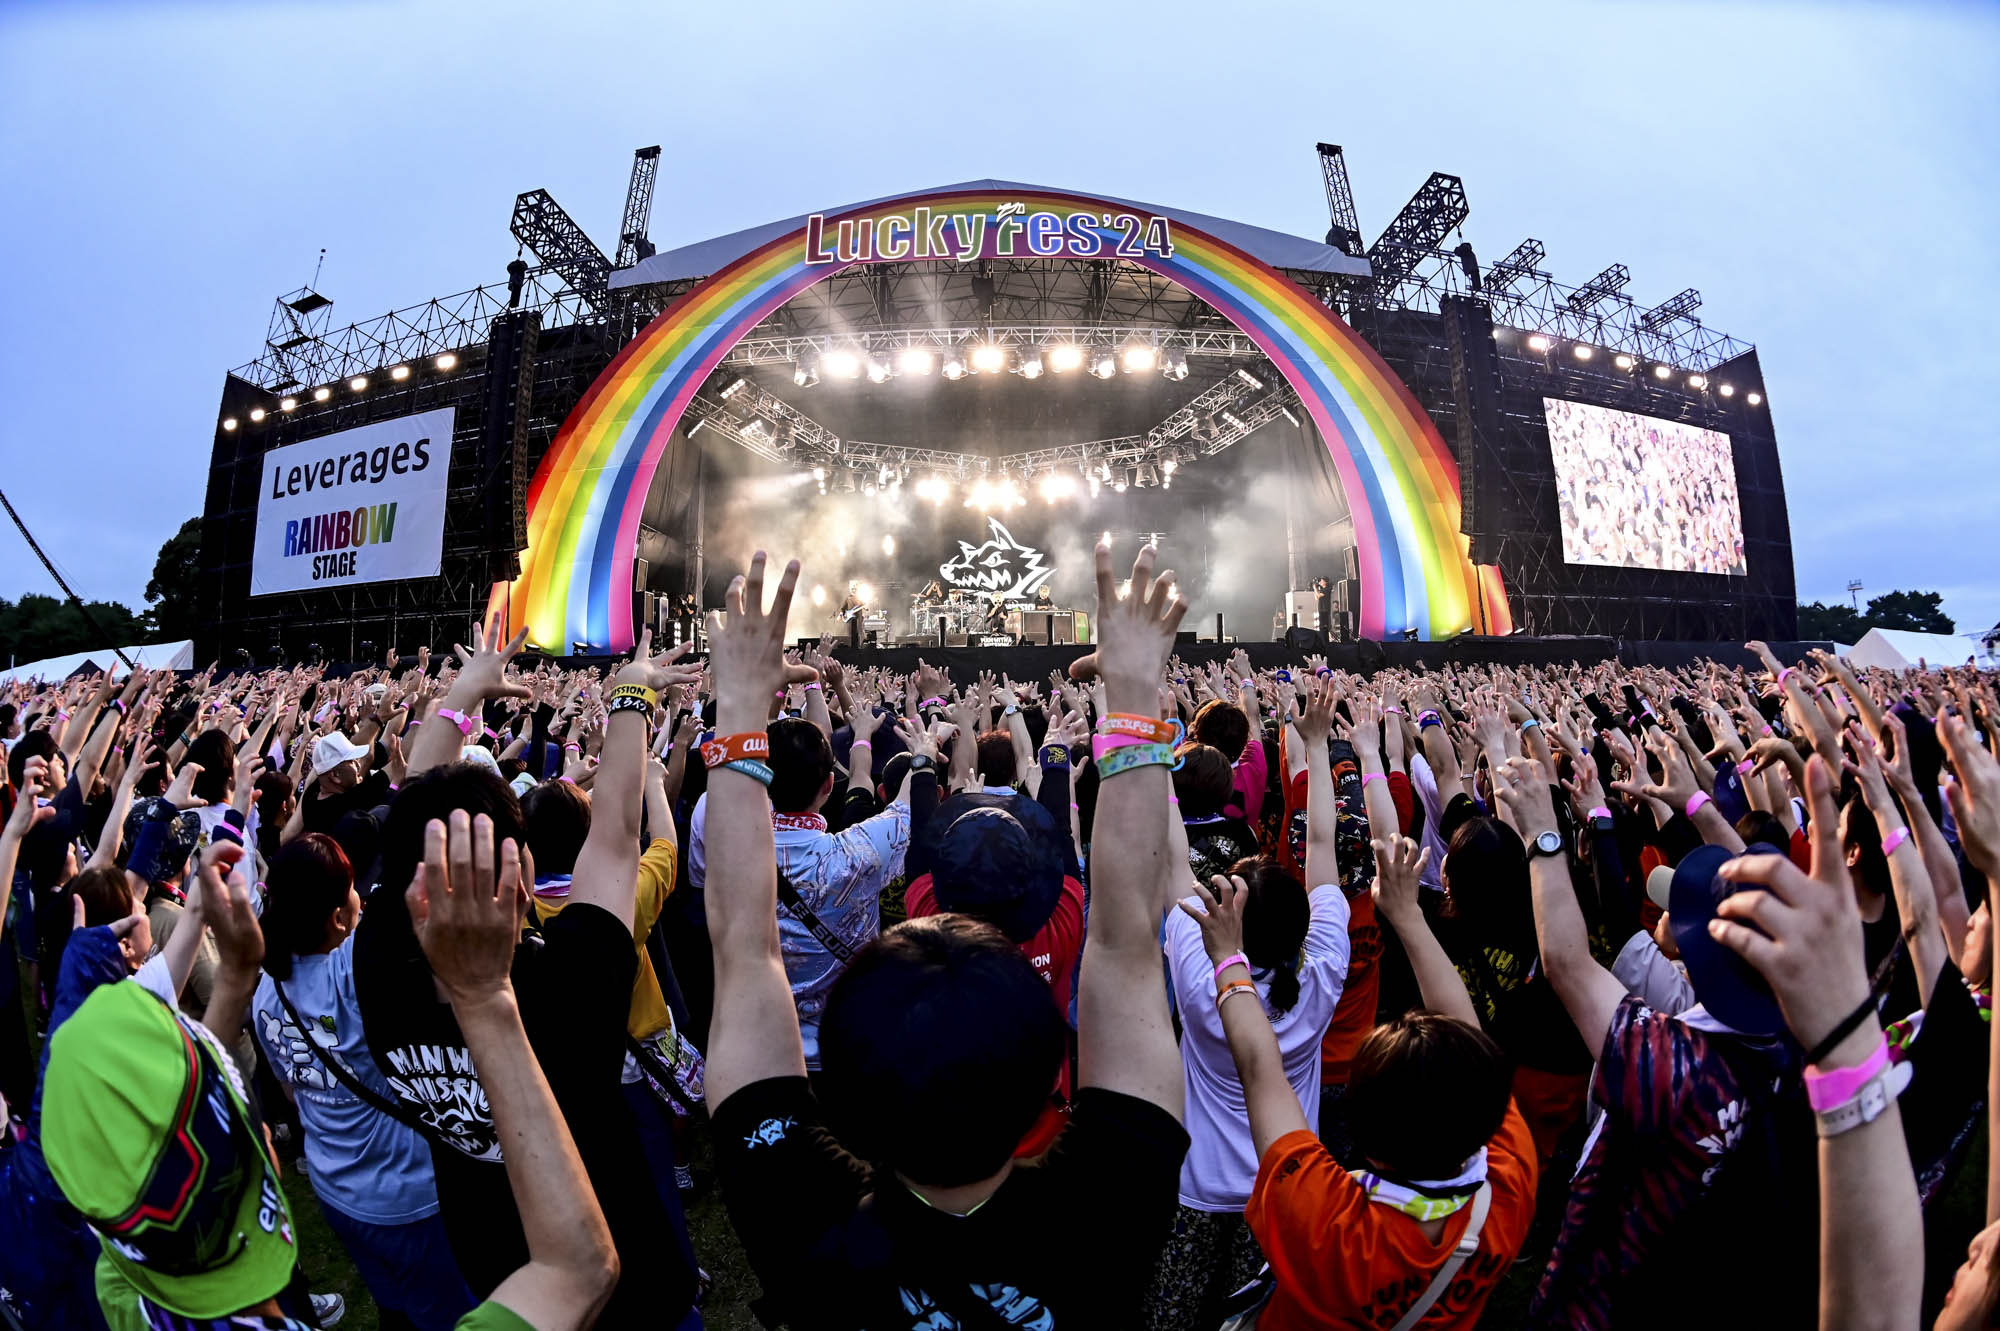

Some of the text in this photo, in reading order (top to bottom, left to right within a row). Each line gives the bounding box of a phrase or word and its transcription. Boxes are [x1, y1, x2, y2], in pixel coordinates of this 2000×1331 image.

[272, 438, 431, 500] Leverages
[283, 502, 398, 558] RAINBOW
[312, 551, 357, 580] STAGE
[386, 1044, 446, 1076] MAN
